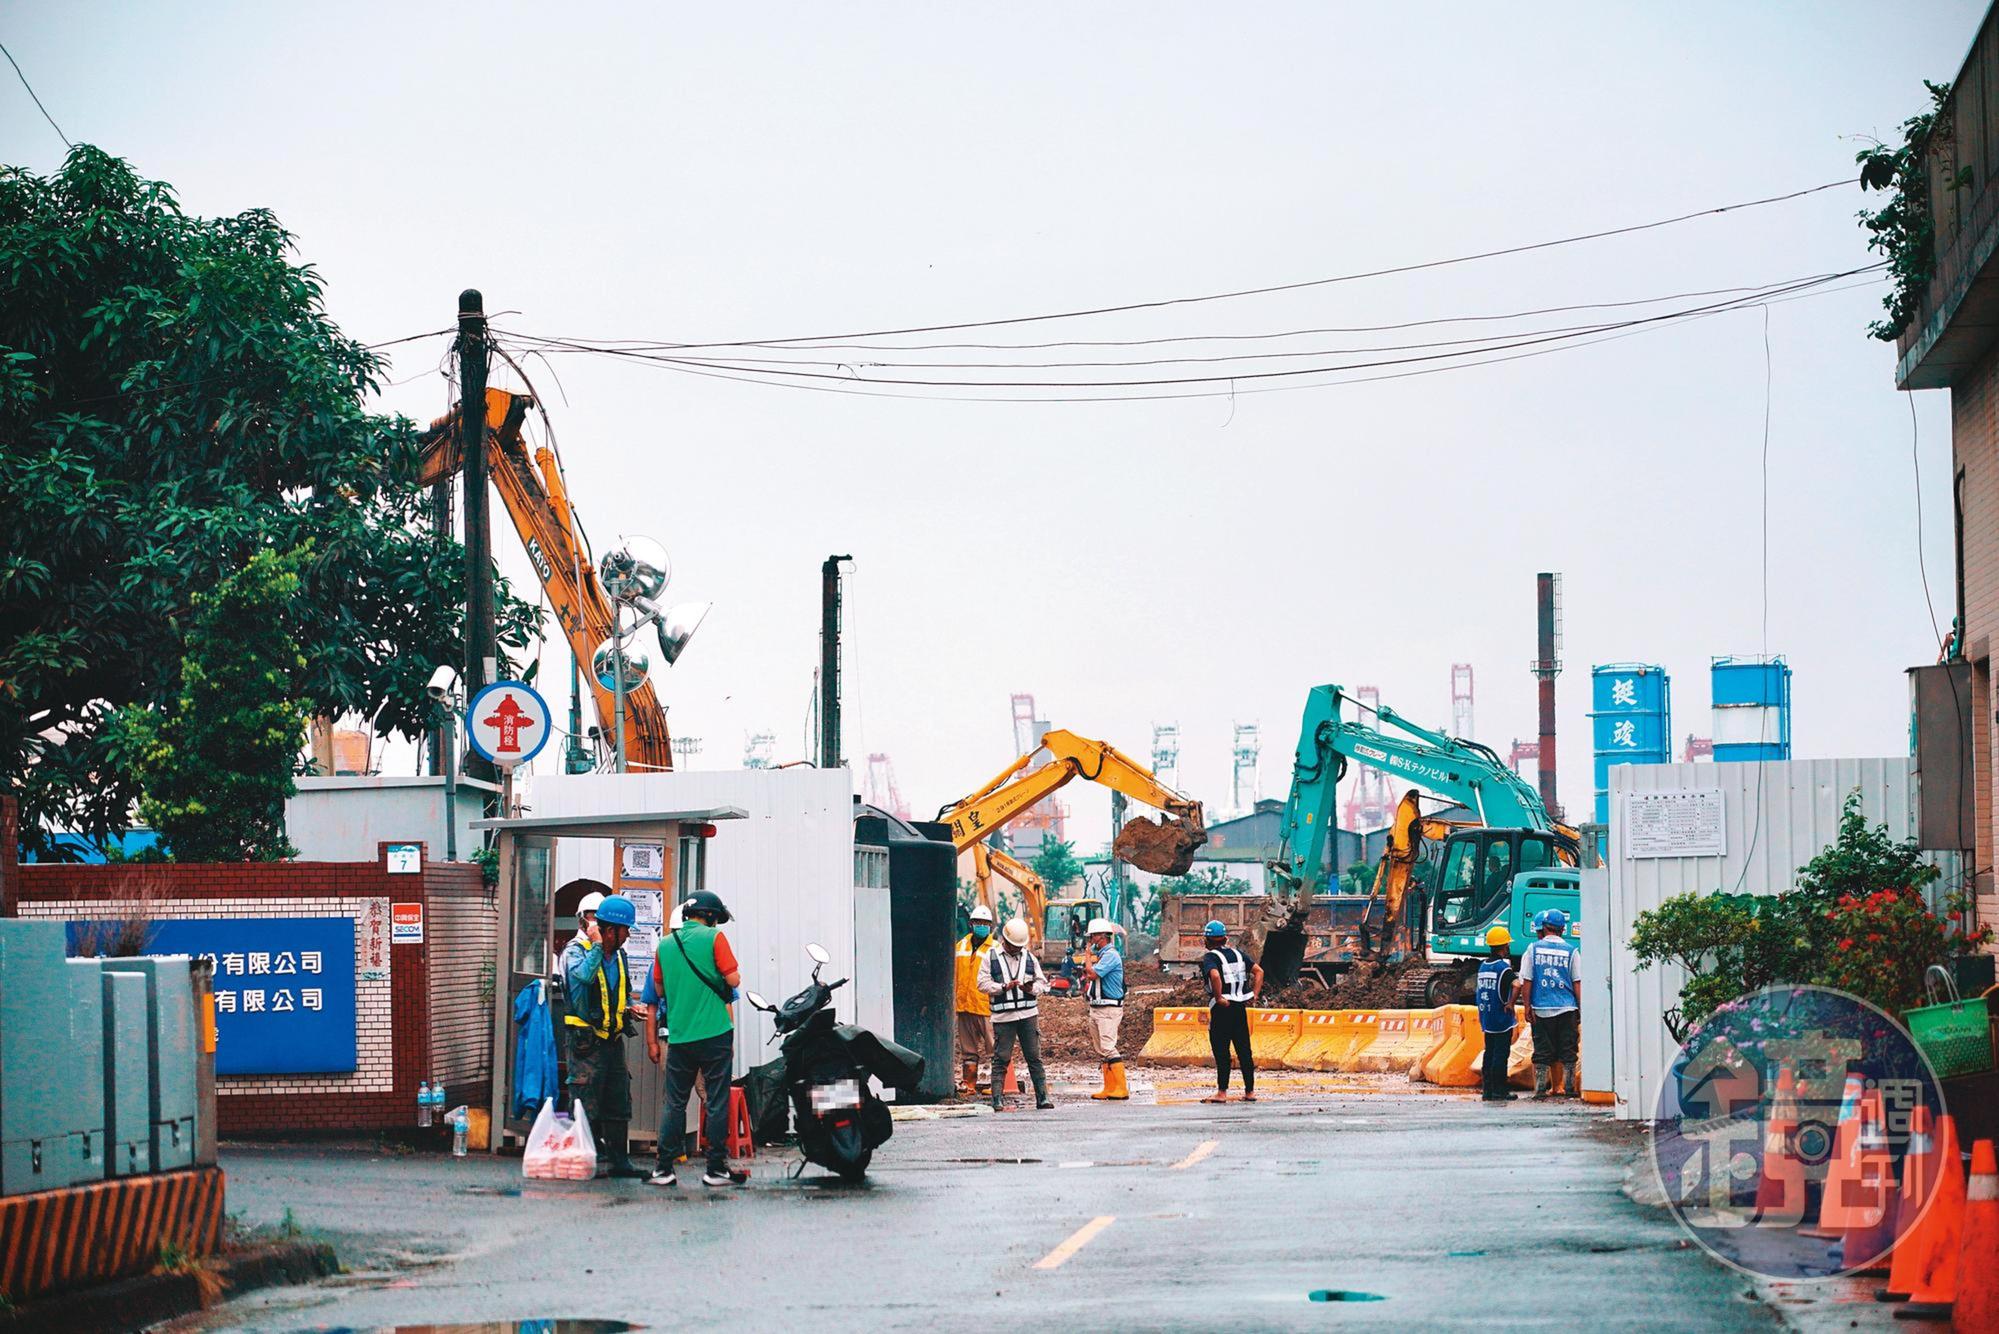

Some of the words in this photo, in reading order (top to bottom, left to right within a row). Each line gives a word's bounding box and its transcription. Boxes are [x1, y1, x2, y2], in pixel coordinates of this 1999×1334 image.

[529, 537, 551, 579] KATO
[503, 714, 514, 746] 消防栓
[401, 859, 407, 871] 7
[369, 900, 384, 968] 恭賀新禧
[395, 925, 420, 933] SECOM
